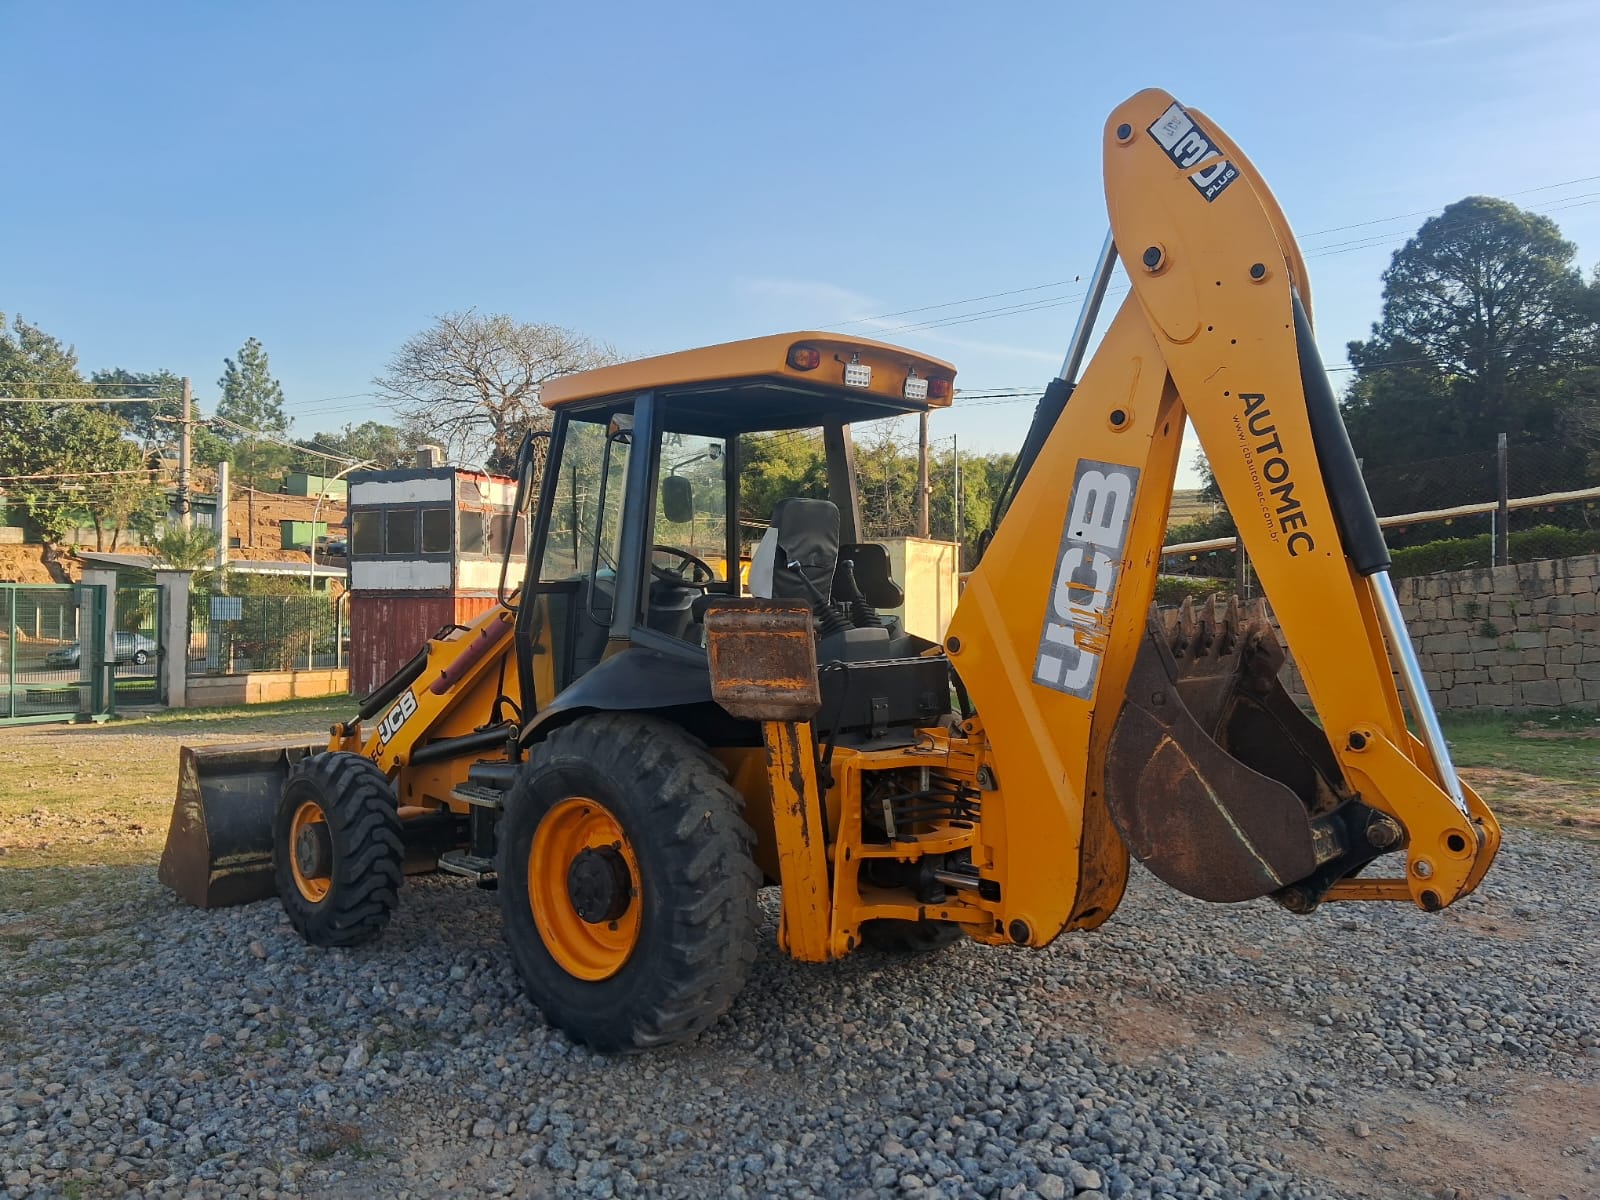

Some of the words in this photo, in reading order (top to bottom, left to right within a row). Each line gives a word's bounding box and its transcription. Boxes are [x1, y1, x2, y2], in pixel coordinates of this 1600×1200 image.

[1205, 168, 1236, 198] PLUS
[1232, 414, 1279, 543] www.jcbautomec.com.br
[1238, 393, 1315, 557] AUTOMEC
[1036, 470, 1131, 691] JCB
[379, 691, 417, 744] JCB
